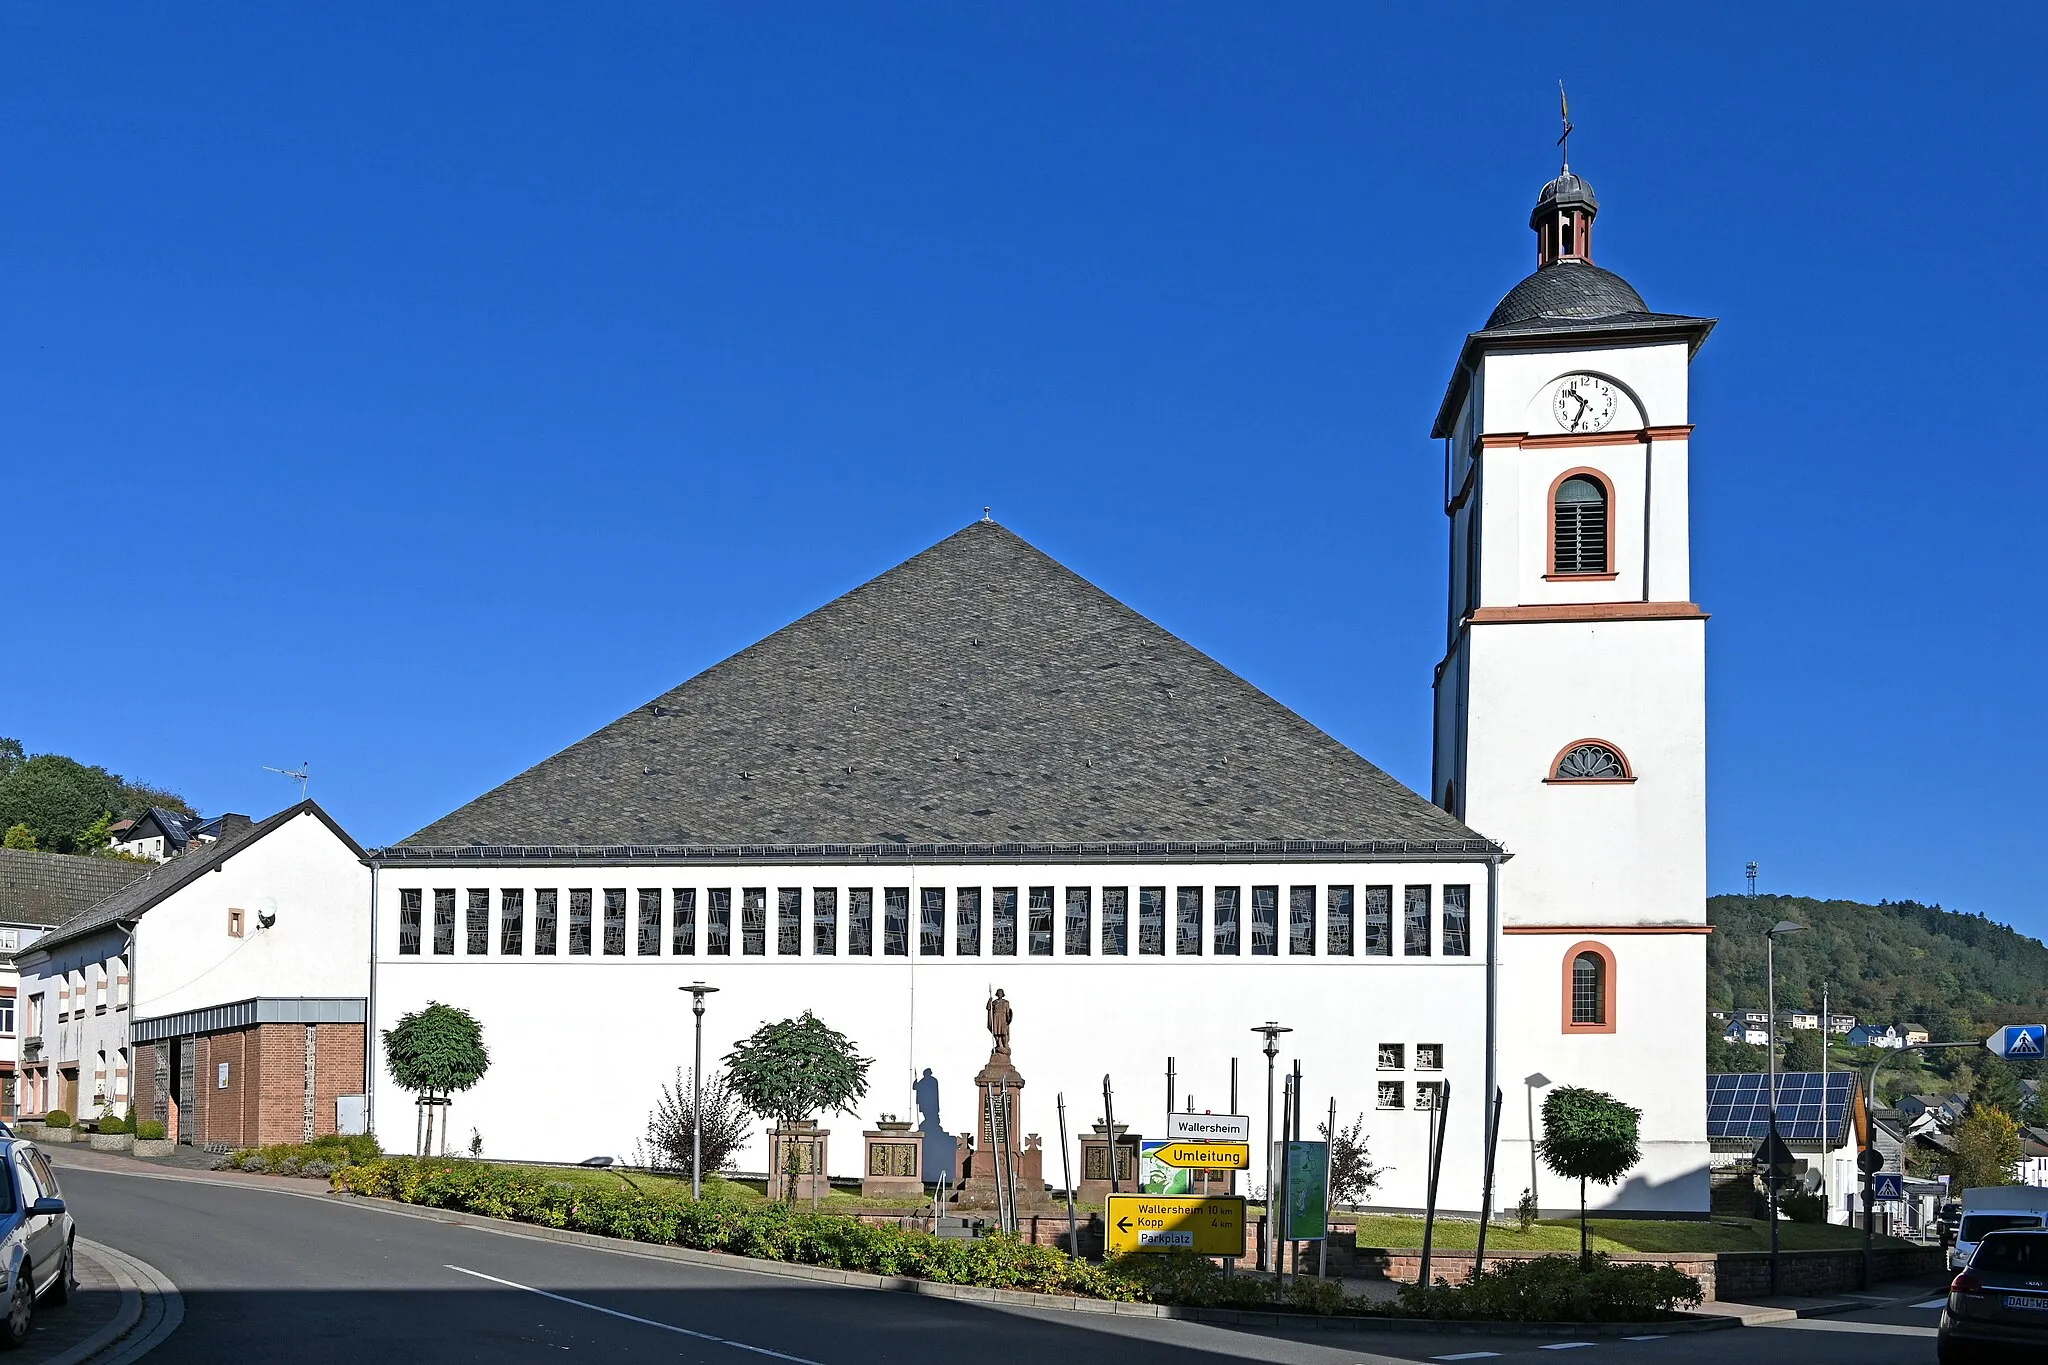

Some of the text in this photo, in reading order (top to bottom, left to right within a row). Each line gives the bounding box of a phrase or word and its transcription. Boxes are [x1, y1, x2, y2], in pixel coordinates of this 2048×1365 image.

[1571, 381, 1577, 389] 11
[1581, 377, 1590, 386] 12
[1602, 387, 1608, 396] 2
[1559, 400, 1565, 409] 9
[1607, 397, 1612, 407] 3
[1562, 411, 1567, 420] 8
[1602, 408, 1608, 417] 4
[1582, 421, 1588, 430] 6
[1594, 418, 1600, 427] 5
[1178, 1121, 1241, 1134] Wallersheim
[1174, 1149, 1241, 1165] Umleitung
[1138, 1204, 1233, 1216] Wallersheim 10 km
[1137, 1217, 1233, 1229] Kopp 4 km
[1141, 1233, 1191, 1246] Parkplatz
[2009, 1297, 2029, 1306] DAU
